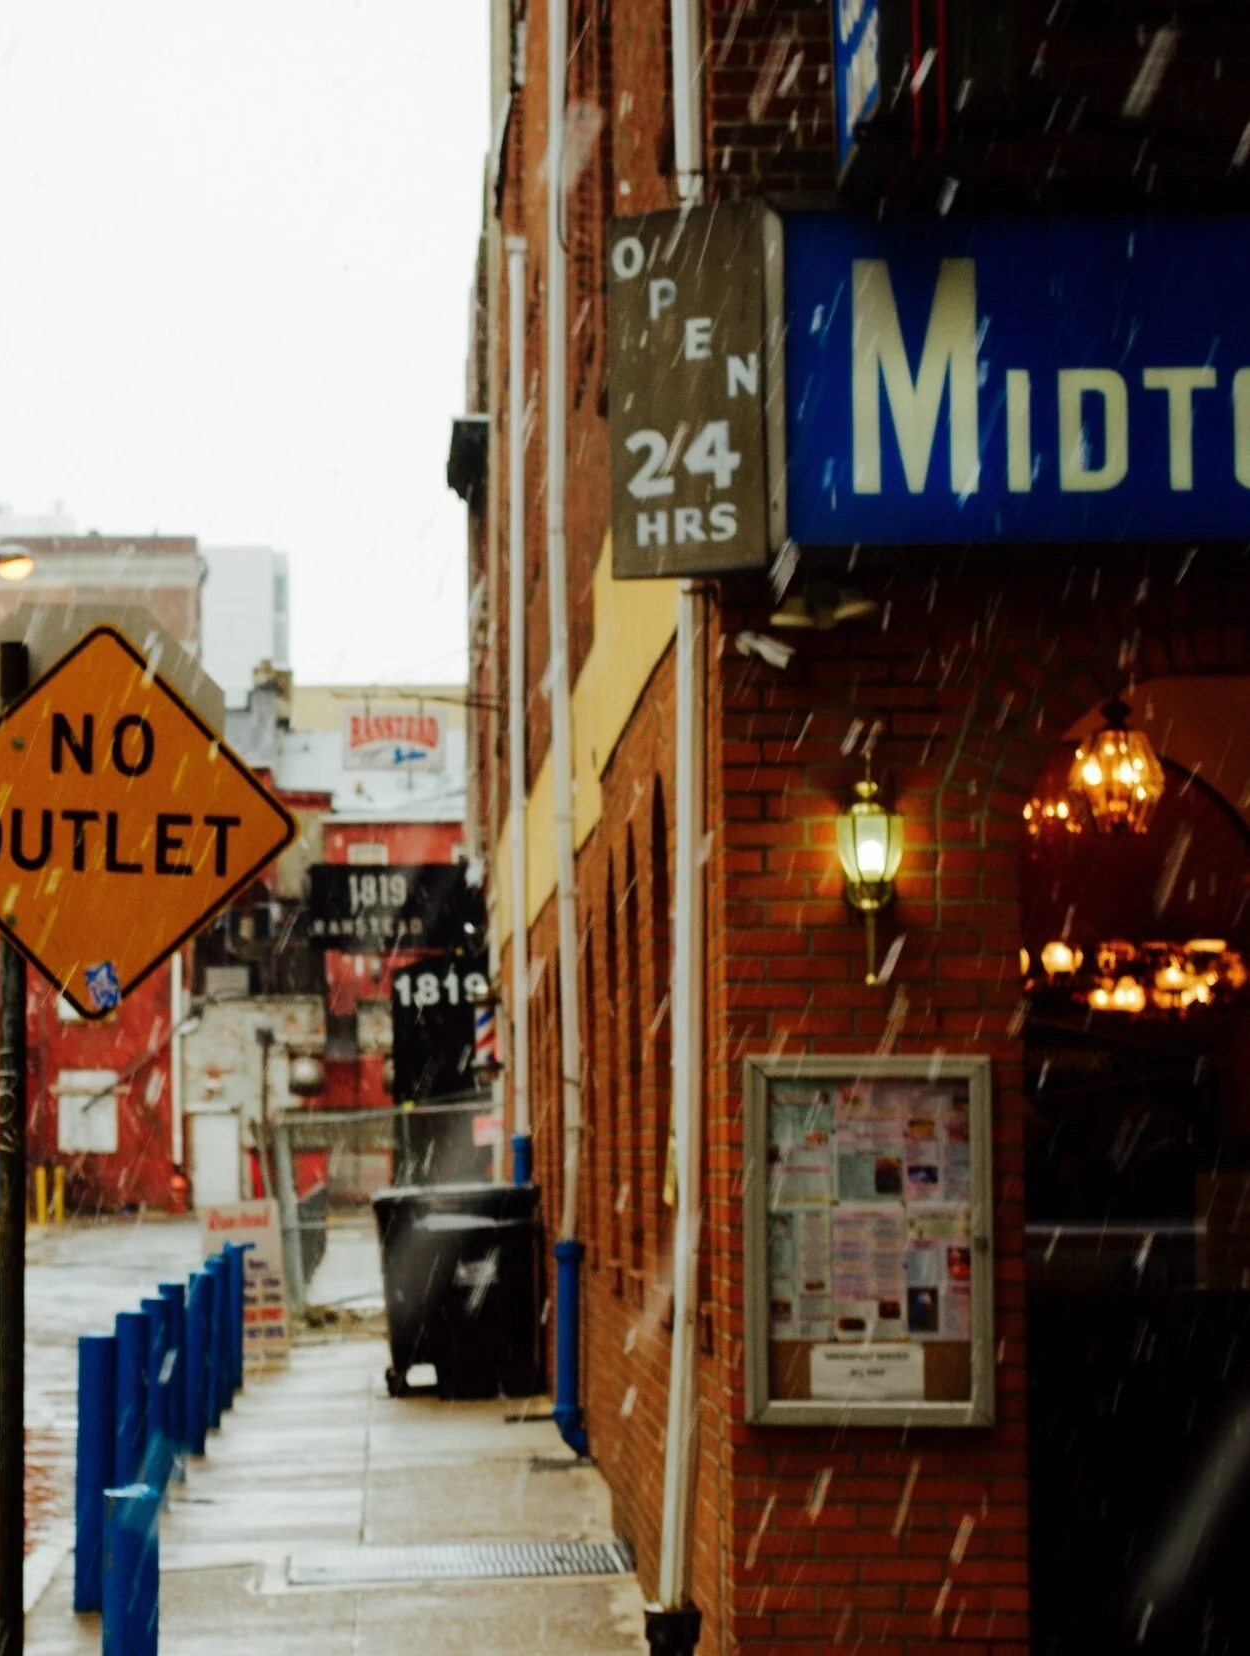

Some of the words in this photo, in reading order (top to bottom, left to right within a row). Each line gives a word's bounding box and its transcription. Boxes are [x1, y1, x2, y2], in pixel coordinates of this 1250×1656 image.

[612, 236, 758, 398] OPEN
[852, 258, 1250, 494] MIDT
[625, 420, 741, 500] 24
[636, 503, 738, 547] HRS
[51, 712, 155, 777] NO
[349, 873, 407, 908] 1819
[395, 971, 488, 1007] 1819
